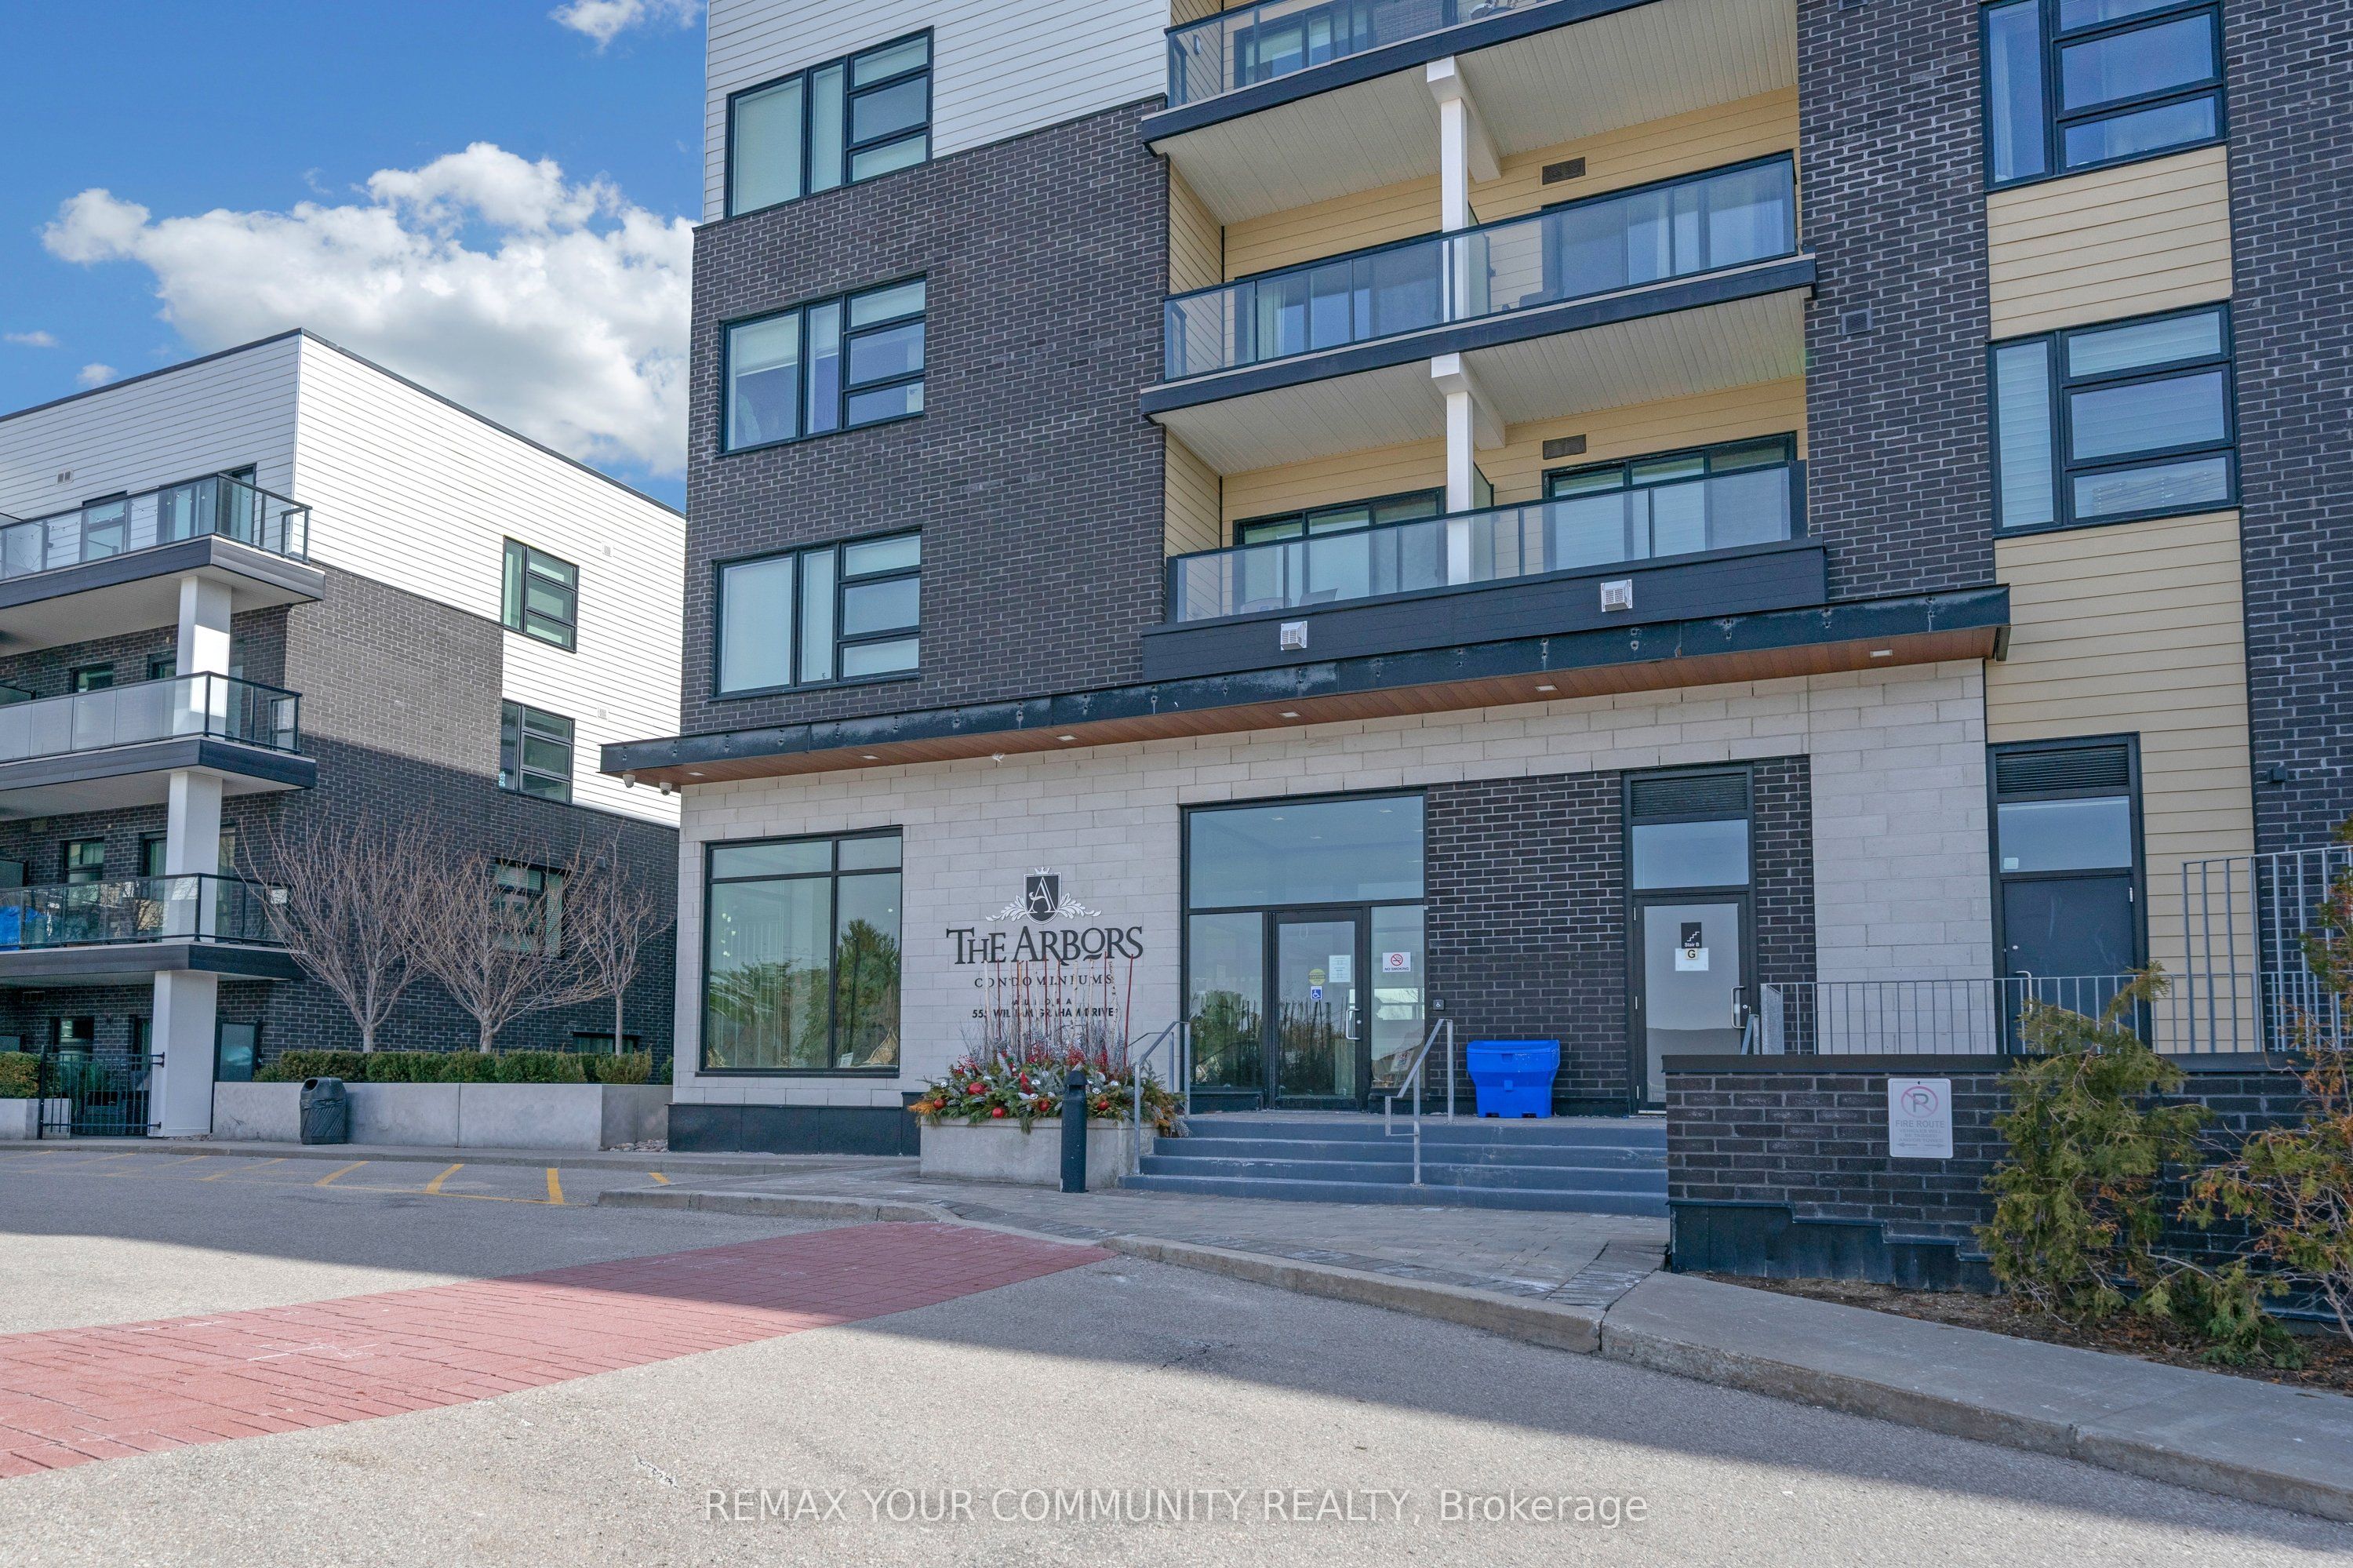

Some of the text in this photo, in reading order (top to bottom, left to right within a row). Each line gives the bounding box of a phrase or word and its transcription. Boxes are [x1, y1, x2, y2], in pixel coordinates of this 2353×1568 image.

[1028, 876, 1059, 913] A
[946, 926, 1144, 966] THE ARBORS
[1687, 949, 1696, 959] G
[974, 974, 1112, 988] CONDOMINIUMS
[1895, 1119, 1914, 1128] FIRE
